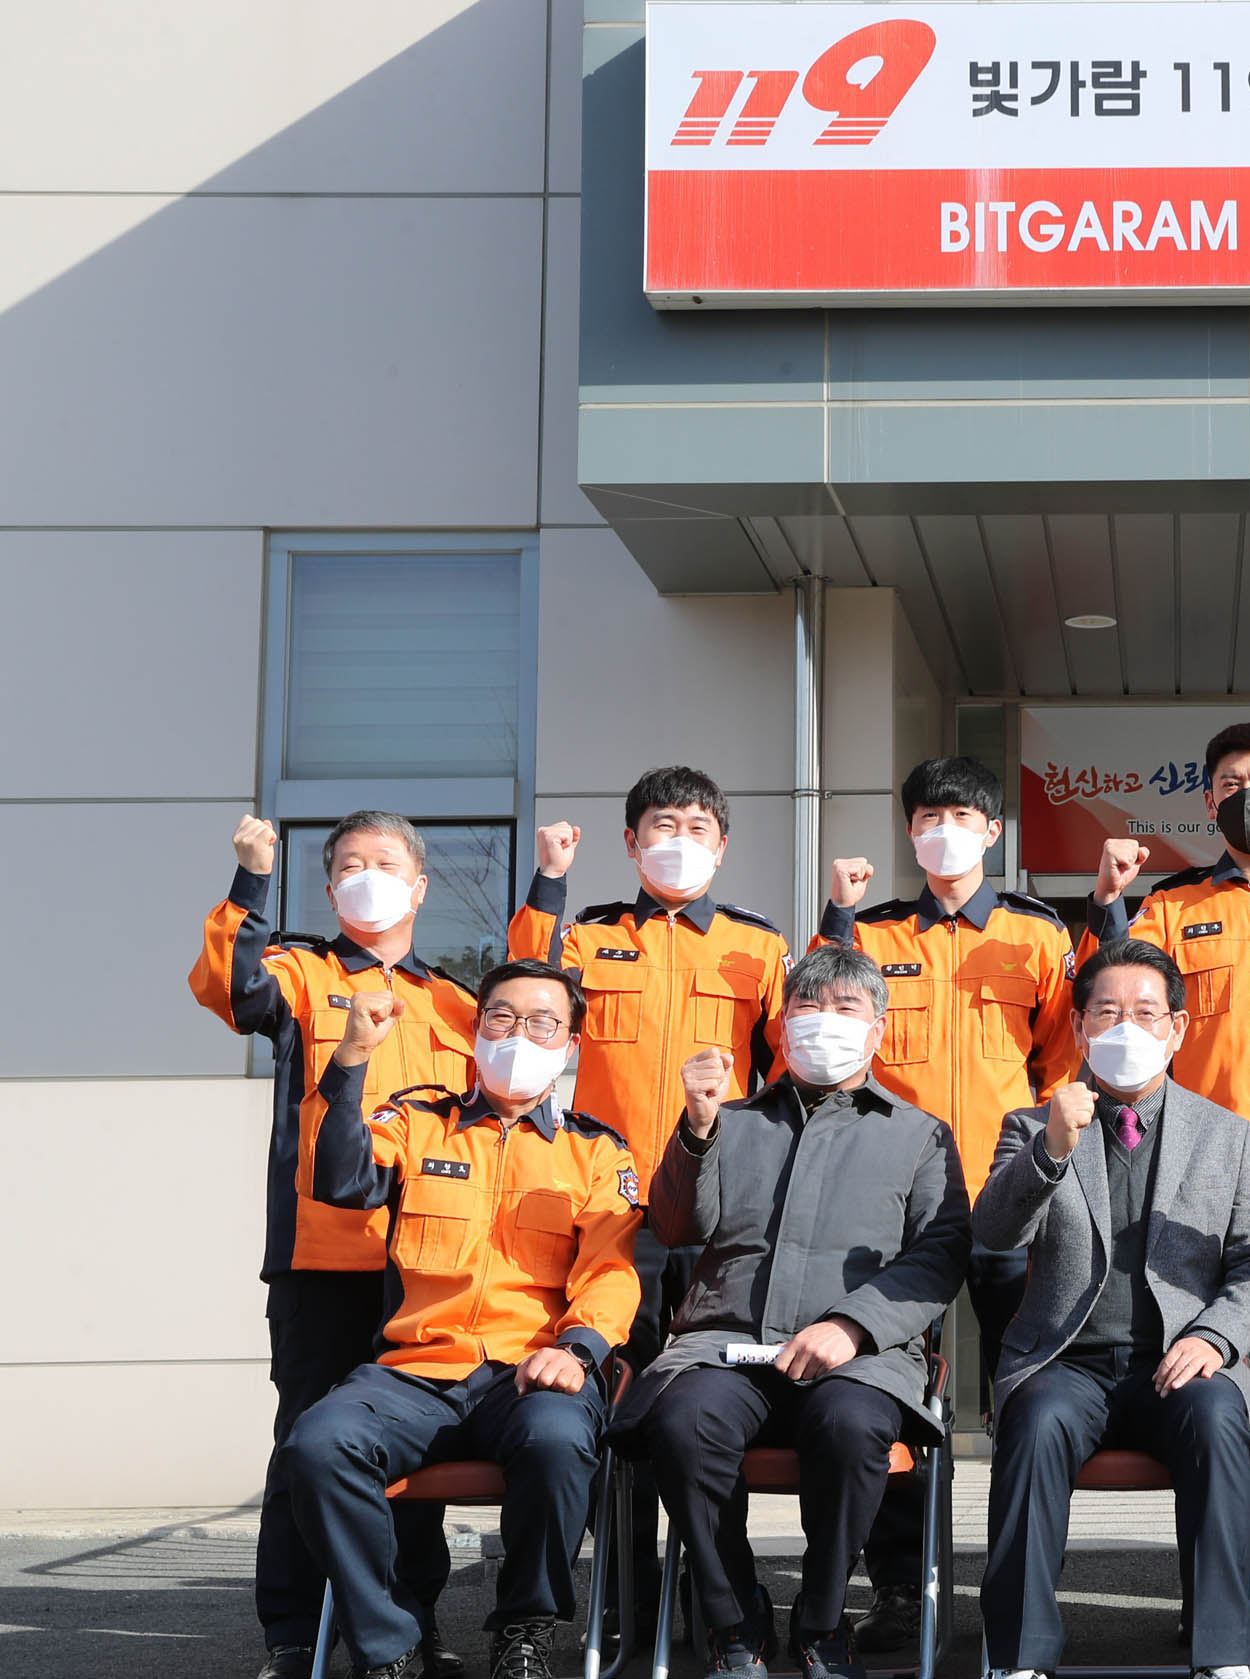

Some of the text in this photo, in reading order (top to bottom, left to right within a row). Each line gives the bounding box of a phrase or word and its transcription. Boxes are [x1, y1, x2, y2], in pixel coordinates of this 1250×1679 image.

[672, 19, 936, 146] 119
[969, 60, 1148, 118] 빛가람
[940, 199, 1238, 253] BITGARAM
[1128, 820, 1155, 833] This
[1161, 820, 1172, 833] is
[1177, 823, 1201, 833] our
